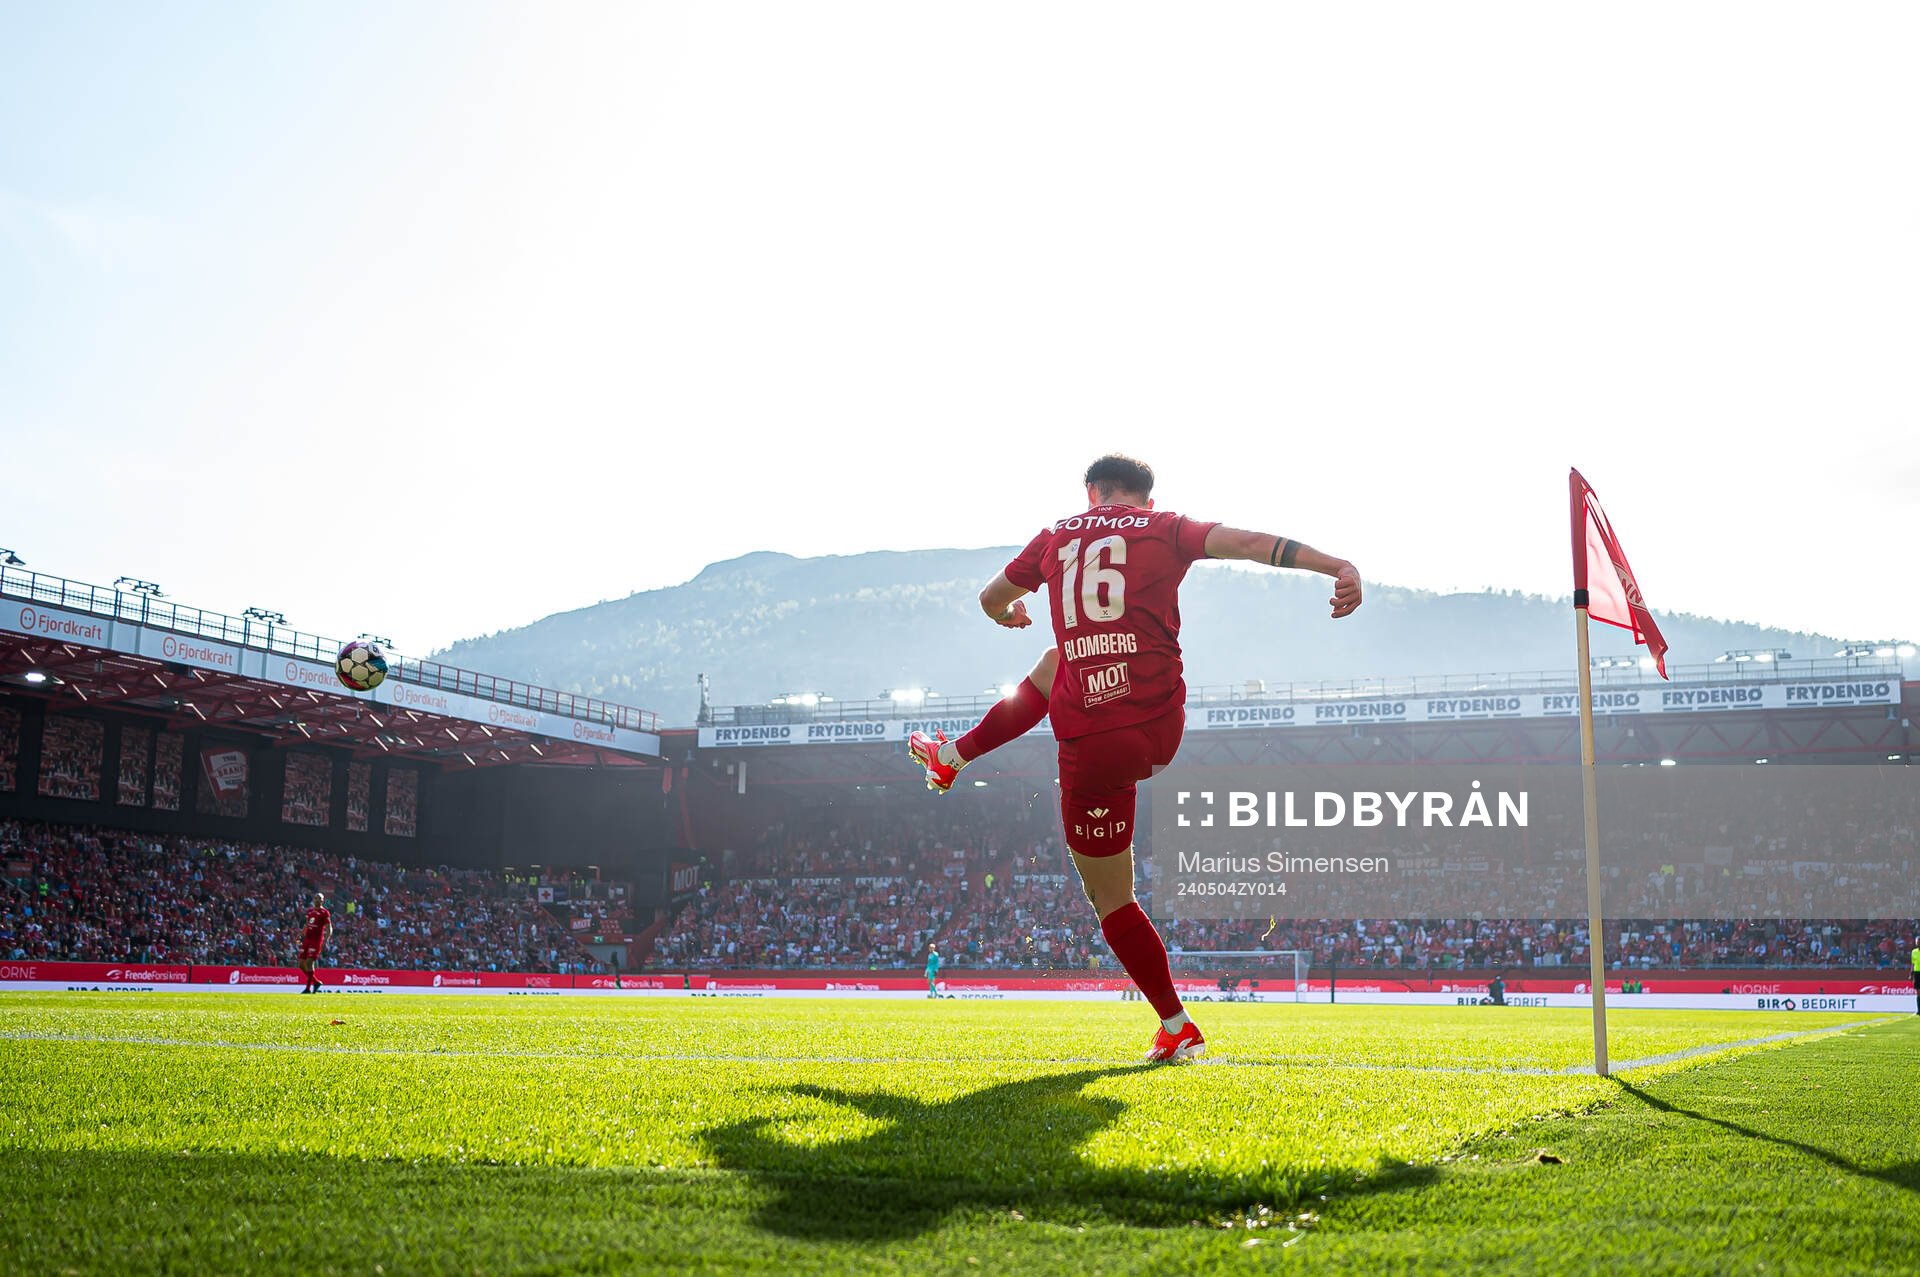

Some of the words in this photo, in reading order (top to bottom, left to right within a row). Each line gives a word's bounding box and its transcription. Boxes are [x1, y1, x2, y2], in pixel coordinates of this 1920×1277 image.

[1052, 515, 1149, 534] FOTMOB
[1058, 534, 1128, 630] 16
[38, 613, 102, 641] Fjordkraft
[178, 642, 233, 667] Fjordkraft
[1064, 632, 1138, 662] BLOMBERG
[299, 667, 342, 688] Fjordkra
[1087, 662, 1128, 694] MOT
[1543, 692, 1640, 710] FRYENBØ
[1662, 687, 1763, 706] FRYDENBØ
[1786, 683, 1890, 701] FRYDENBØ
[1315, 702, 1406, 718] FRYDENBØ
[1428, 697, 1521, 714] FRYDENBØ
[1207, 707, 1295, 723] FRYDENBØ
[715, 725, 791, 741] FRYDENBØ
[807, 722, 886, 738] FRYDENBØ
[0, 966, 37, 980] ORNE
[1506, 997, 1548, 1007] EDRIFT
[1801, 998, 1857, 1009] BEDRIFT
